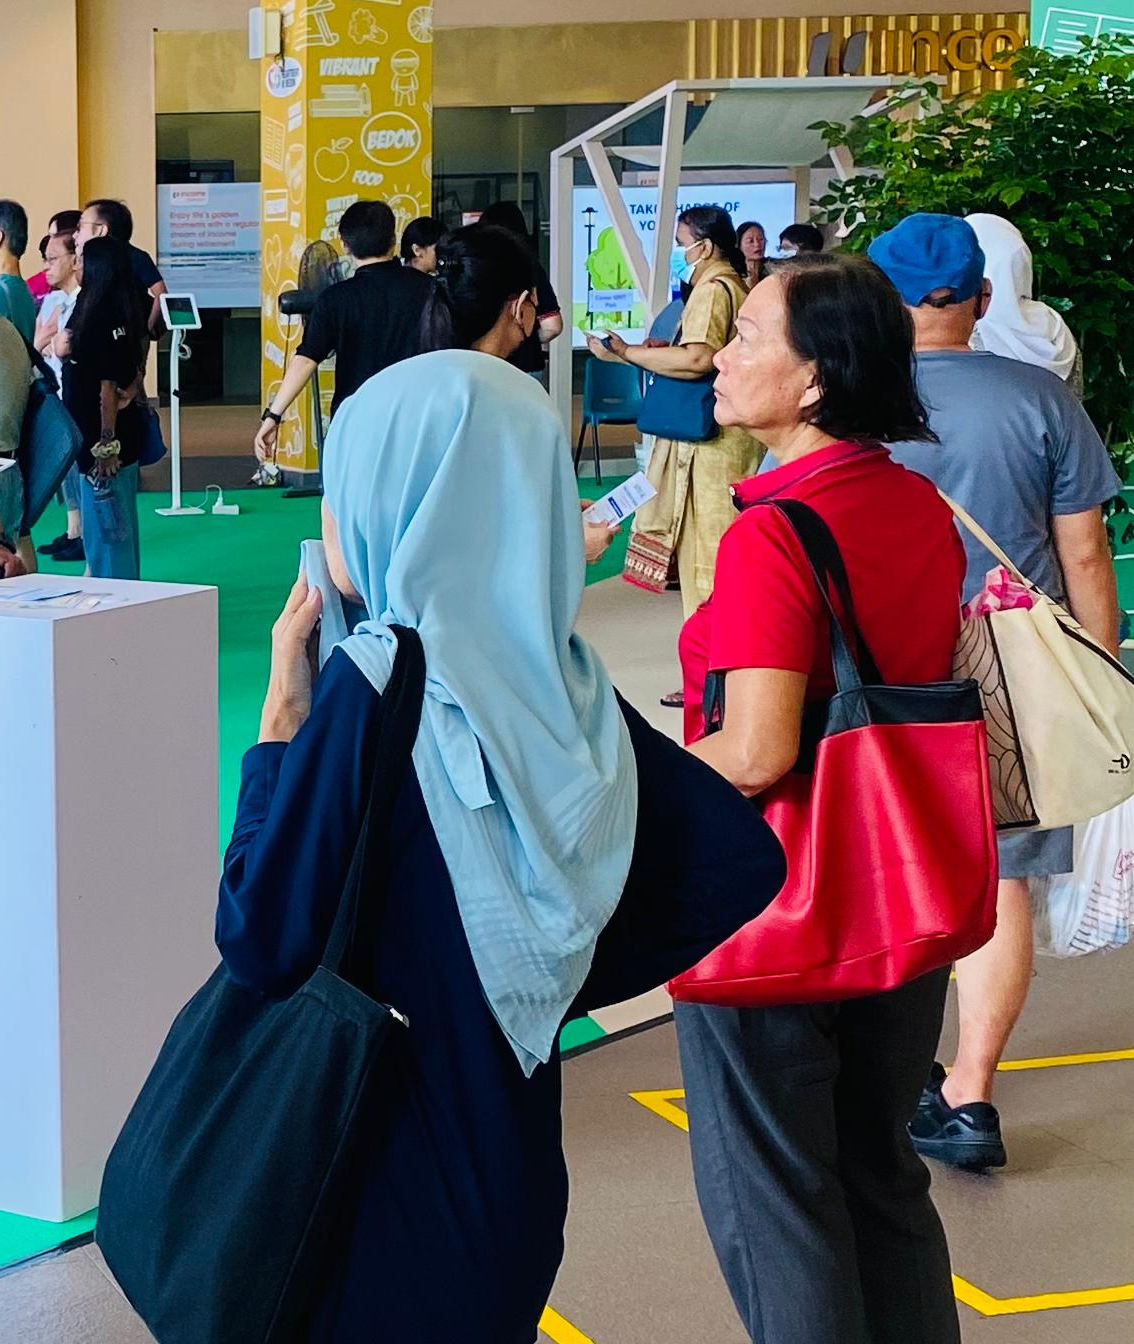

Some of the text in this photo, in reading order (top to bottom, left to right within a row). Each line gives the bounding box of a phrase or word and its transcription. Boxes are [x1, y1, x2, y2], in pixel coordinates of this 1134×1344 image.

[319, 56, 380, 77] VIBRANT
[368, 129, 416, 149] BEDOK
[630, 202, 740, 214] TAK OF
